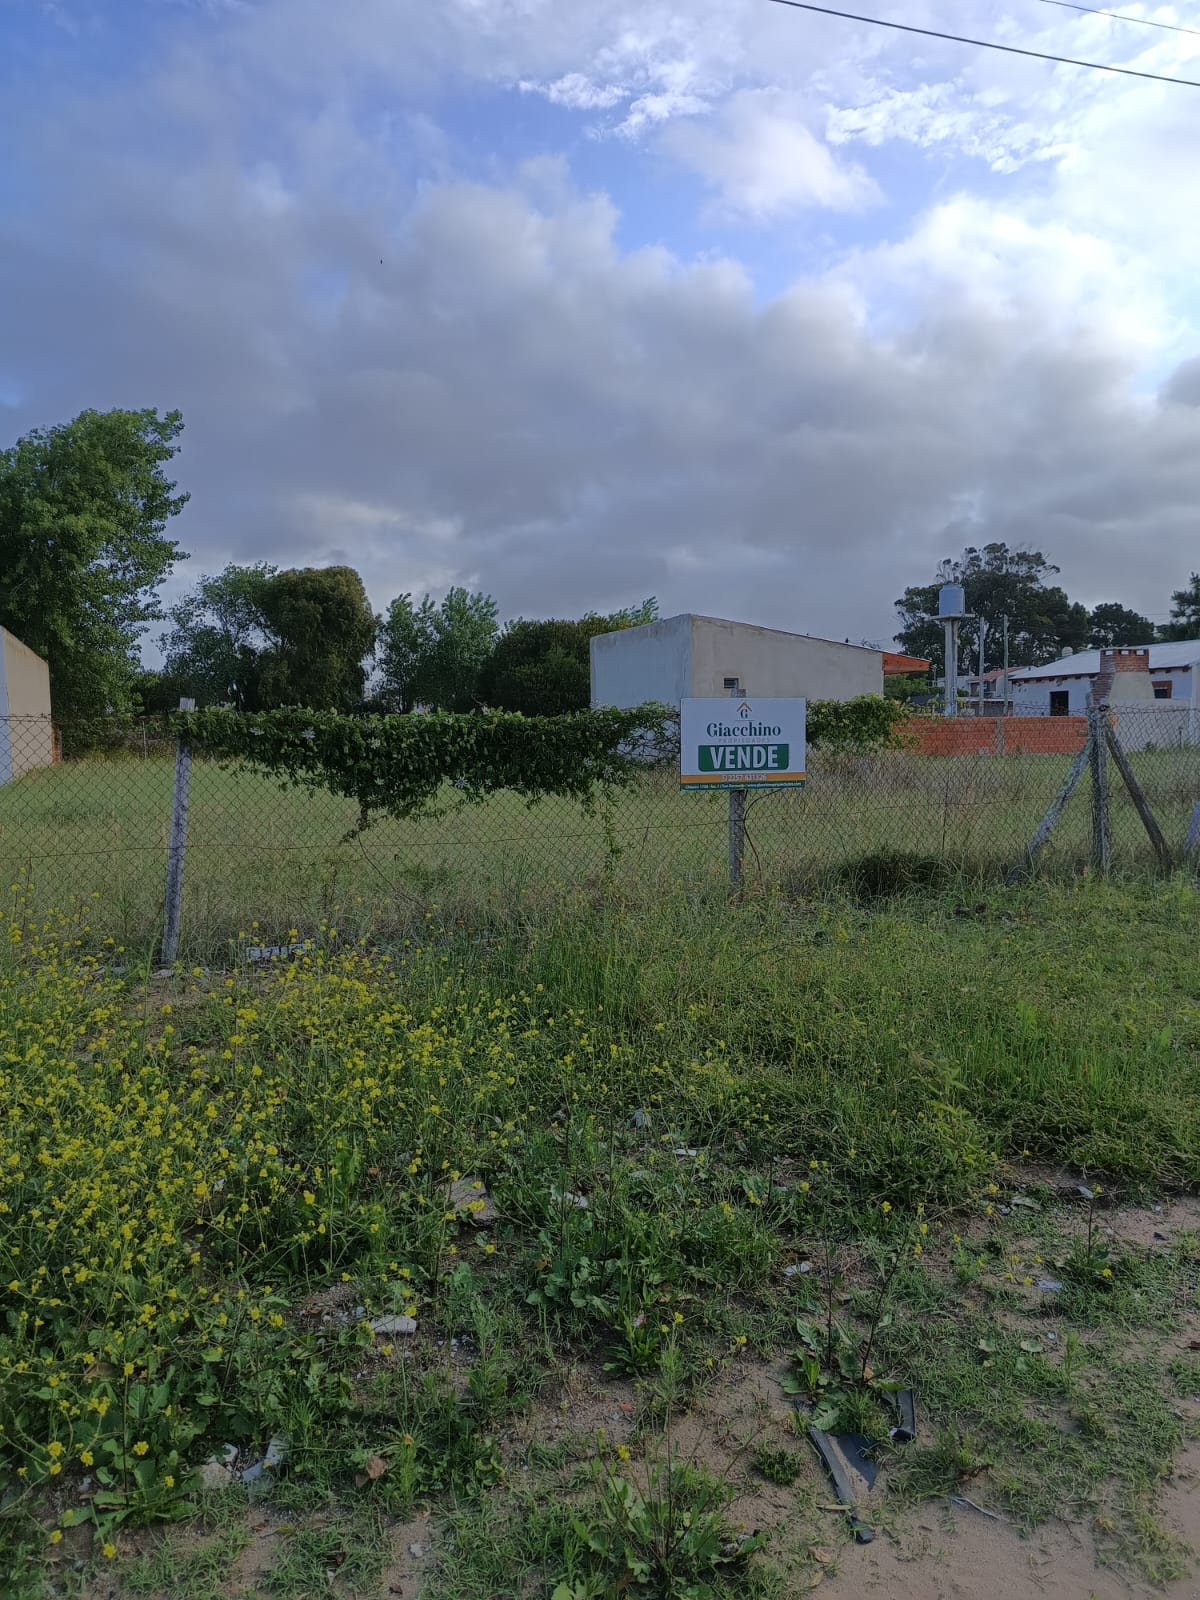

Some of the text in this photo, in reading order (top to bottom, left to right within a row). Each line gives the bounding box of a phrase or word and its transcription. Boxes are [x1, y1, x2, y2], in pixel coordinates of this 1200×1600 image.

[740, 708, 748, 719] G
[706, 721, 781, 737] Giacchino
[710, 745, 778, 769] VENDE
